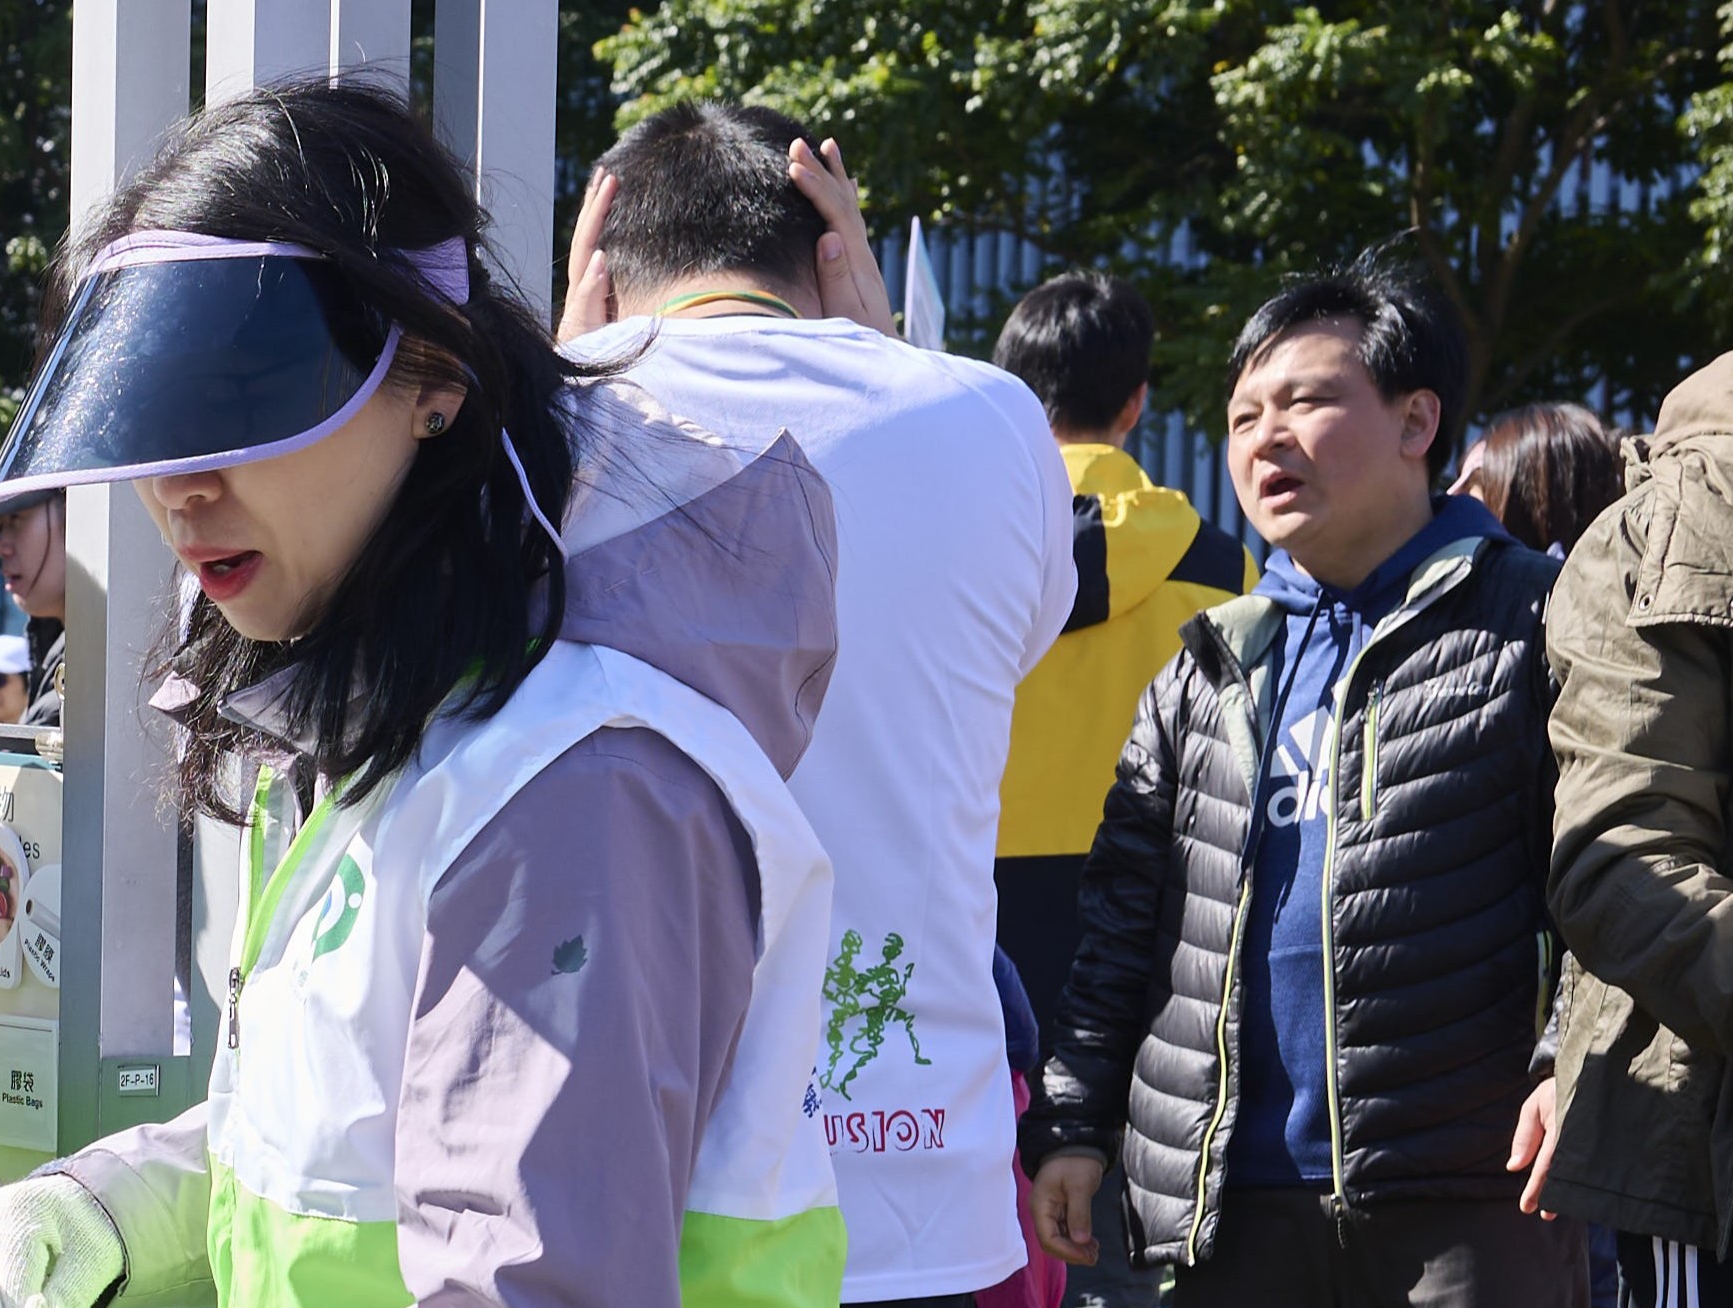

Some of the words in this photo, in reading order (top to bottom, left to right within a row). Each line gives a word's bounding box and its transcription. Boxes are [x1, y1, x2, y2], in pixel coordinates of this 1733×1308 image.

[10, 1070, 35, 1093] 膠袋
[120, 1072, 154, 1087] 2F-P-16
[2, 1092, 25, 1106] Plastic
[25, 1095, 43, 1110] Bags
